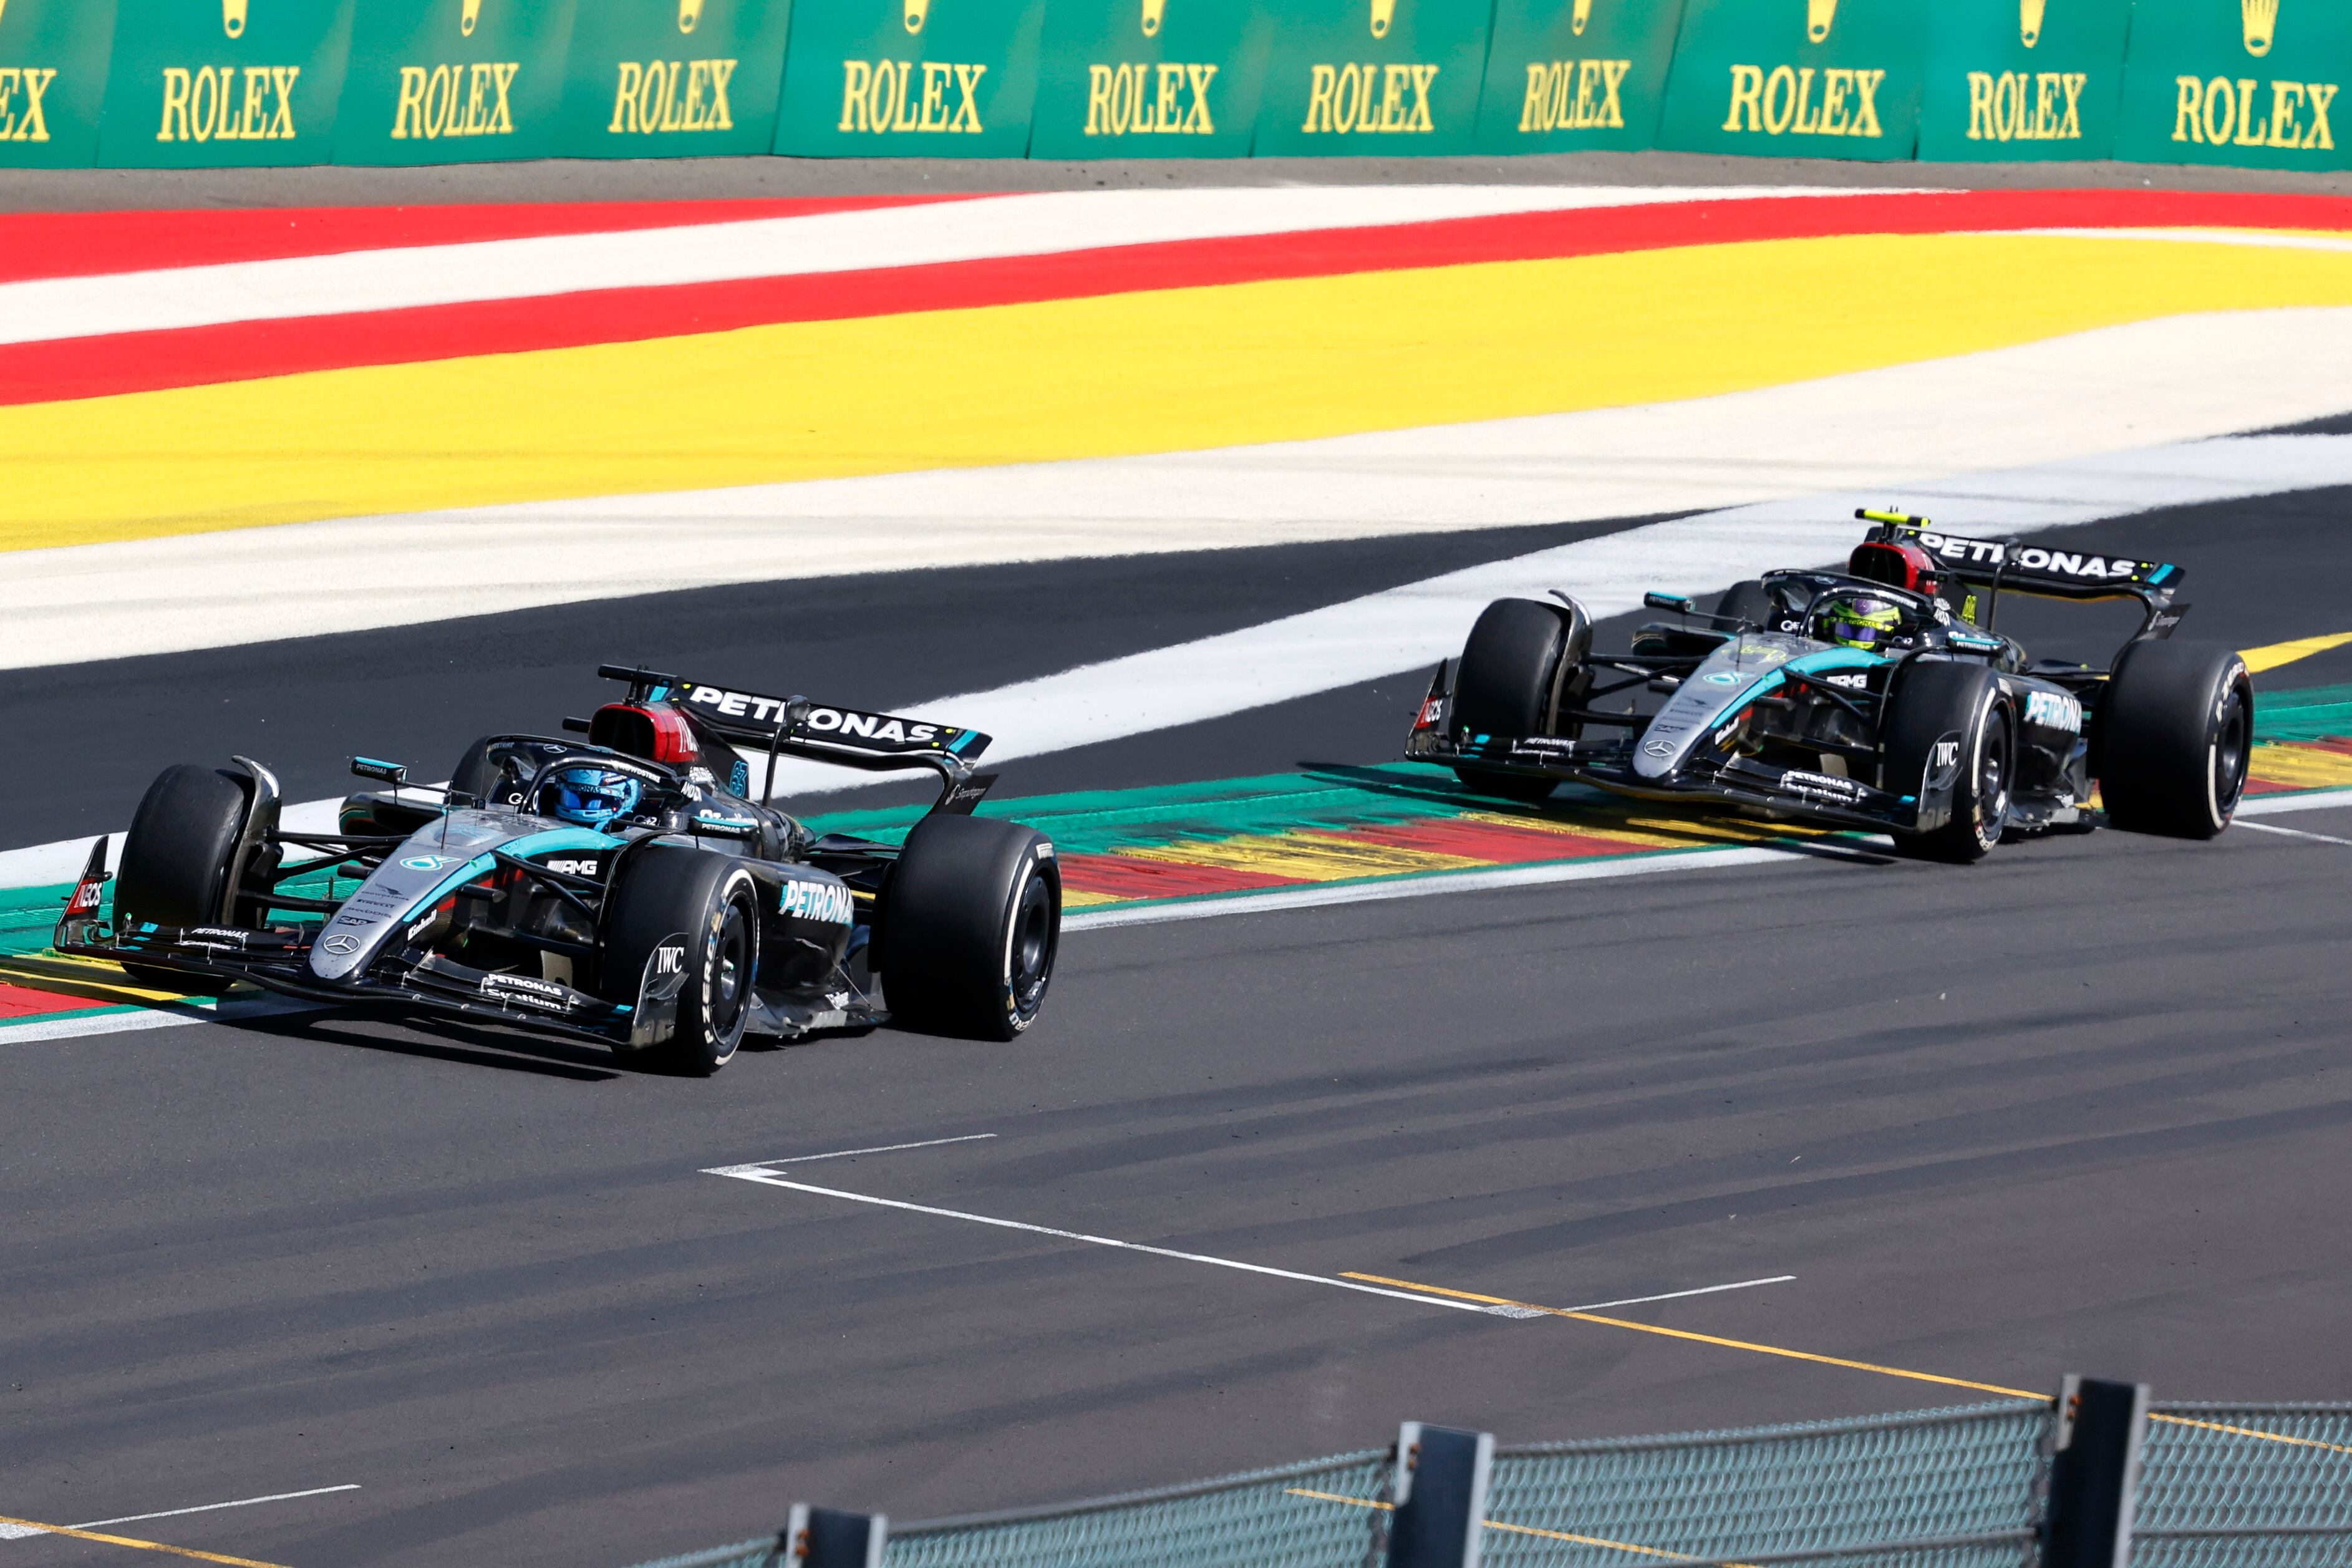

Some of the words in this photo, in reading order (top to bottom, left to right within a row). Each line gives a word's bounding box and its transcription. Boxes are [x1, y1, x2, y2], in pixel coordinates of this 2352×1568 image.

[157, 65, 299, 142] ROLEX
[390, 62, 519, 138] ROLEX
[607, 59, 737, 133] ROLEX
[838, 59, 985, 133] ROLEX
[1085, 62, 1217, 135] ROLEX
[1302, 62, 1438, 133] ROLEX
[1519, 59, 1630, 132] ROLEX
[1723, 65, 1884, 137] ROLEX
[1968, 72, 2086, 140] ROLEX
[2172, 77, 2338, 149] ROLEX
[1837, 674, 1867, 689] AMG
[2023, 690, 2083, 735] PETRONA
[356, 763, 387, 774] PETRONAS
[1936, 741, 1959, 768] IWC
[1786, 770, 1854, 790] PETRONAS
[702, 823, 741, 834] PETRONAS
[561, 860, 598, 875] AMG
[339, 917, 367, 926] SAP
[778, 879, 854, 924] PETRONA
[191, 928, 249, 939] PETRONAS
[407, 908, 437, 941] Einhell
[657, 946, 684, 974] IWC
[488, 973, 563, 996] PETRONAS
